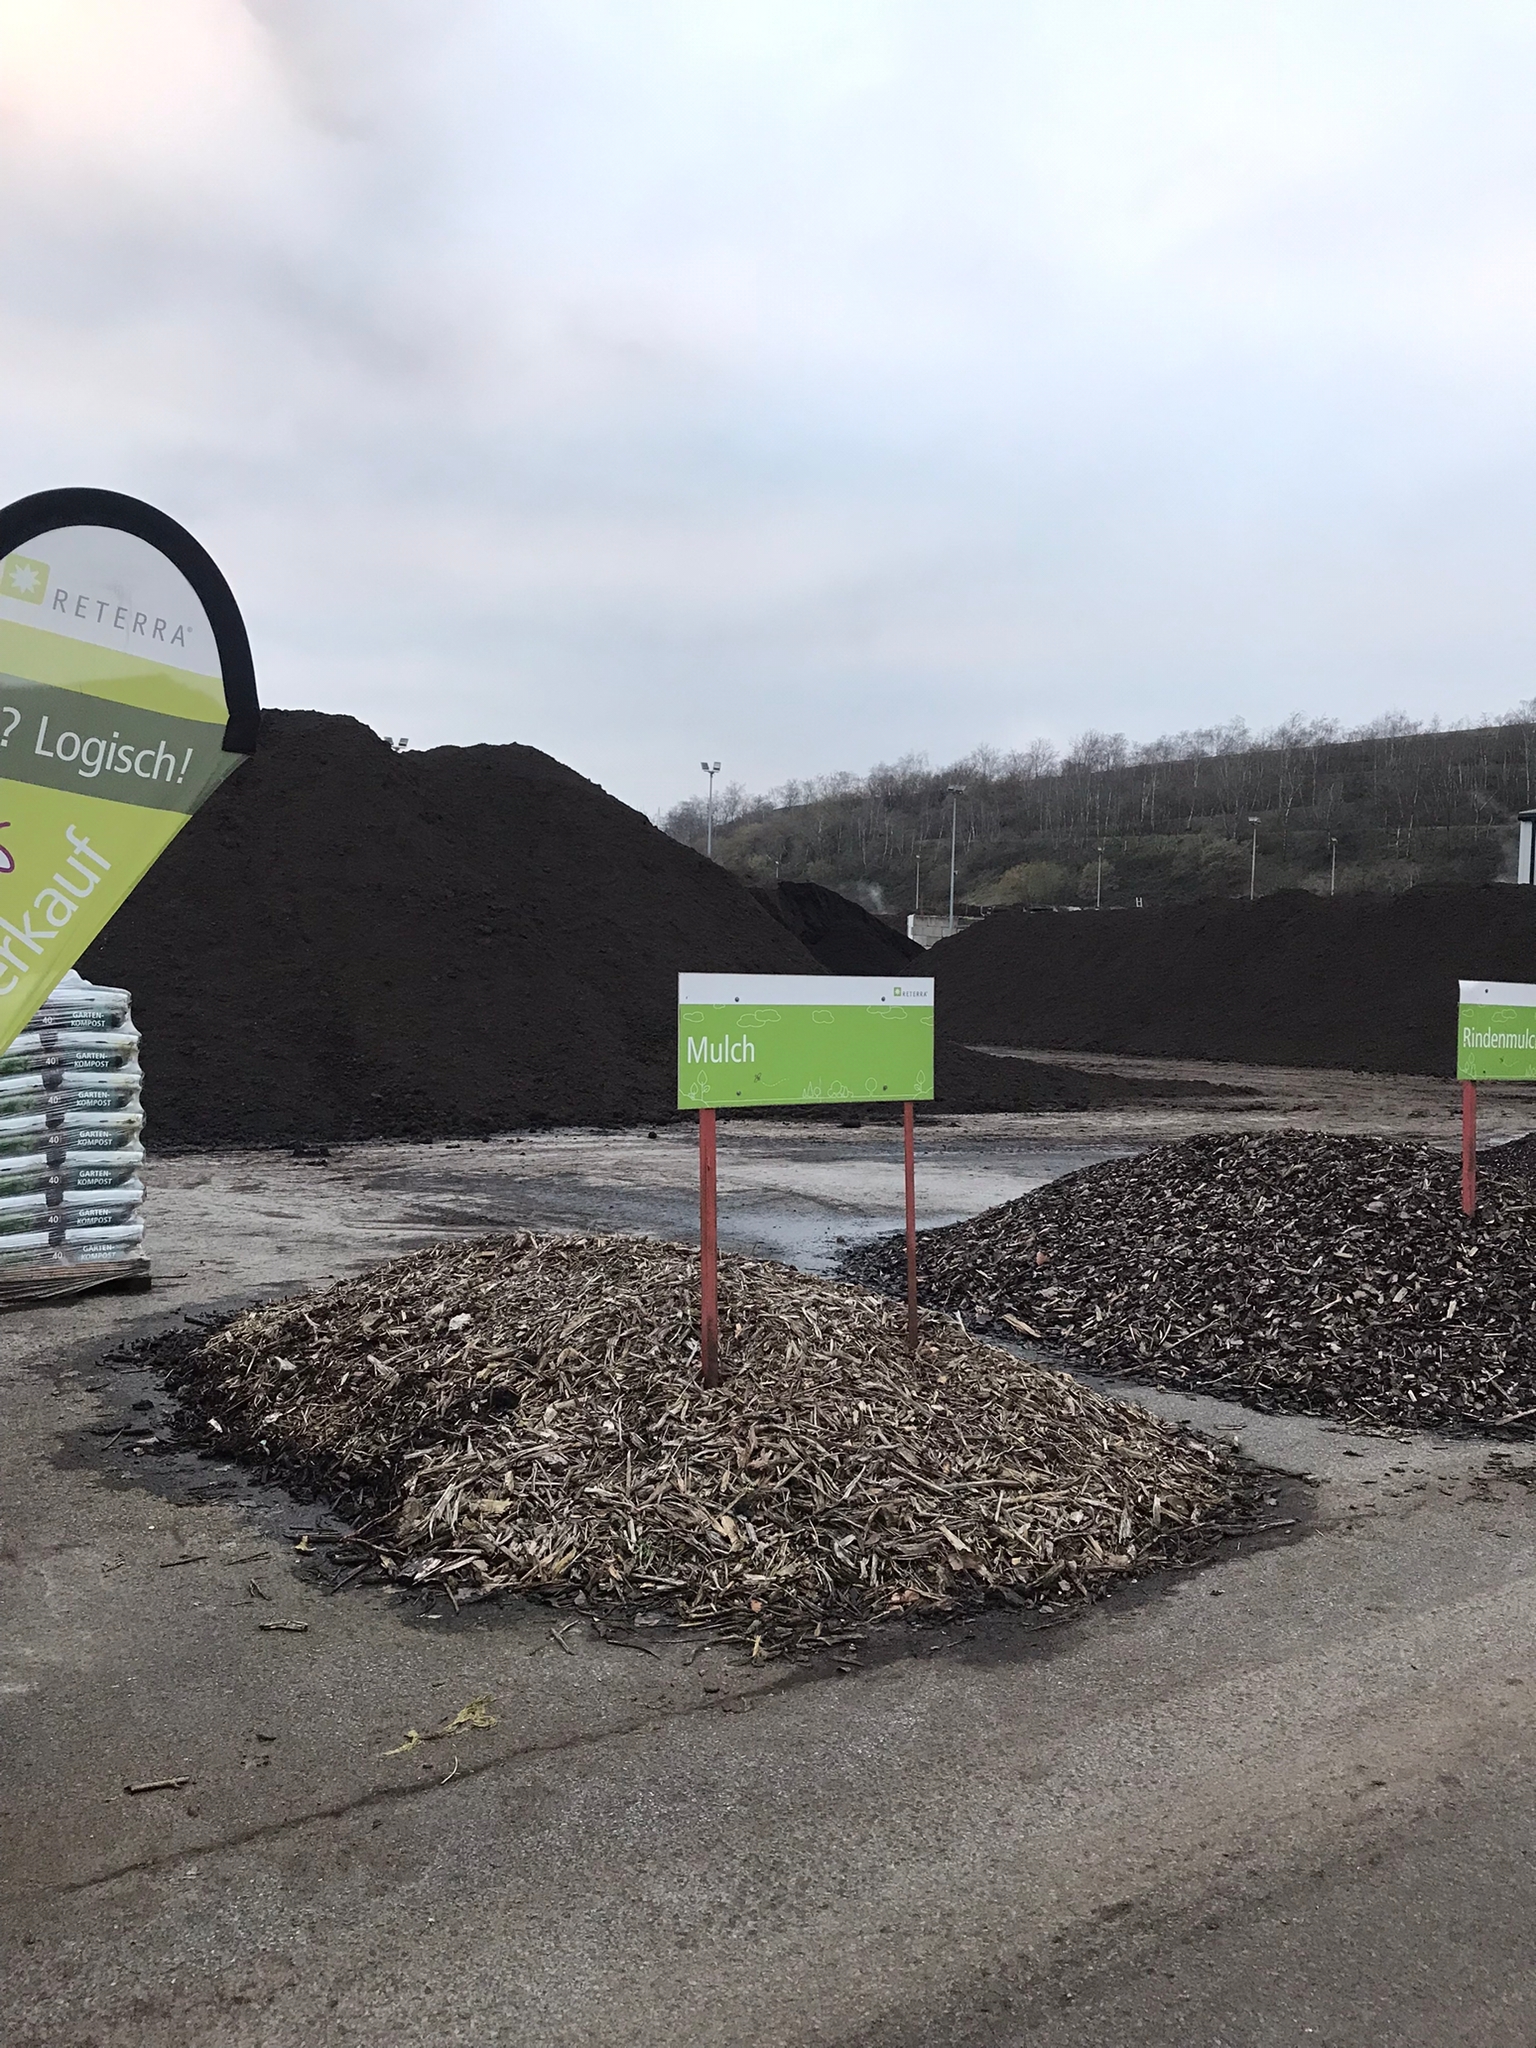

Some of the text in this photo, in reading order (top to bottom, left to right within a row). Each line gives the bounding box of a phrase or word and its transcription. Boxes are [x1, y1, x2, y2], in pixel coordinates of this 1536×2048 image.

[34, 715, 194, 784] Logisch!
[72, 1011, 105, 1019] GARTEN-
[70, 1019, 106, 1027] KOMPOST
[1463, 1026, 1536, 1049] Rindenmulc
[687, 1034, 755, 1063] Mulch
[75, 1052, 108, 1060] GARTEN-
[73, 1060, 110, 1068] KOMPOST
[77, 1091, 111, 1099] GARTEN-
[76, 1099, 112, 1107] KOMPOST
[79, 1130, 112, 1138] GARTEN-
[77, 1138, 113, 1146] KOMPOST
[79, 1170, 112, 1178] GARTEN-
[77, 1178, 113, 1186] KOMPOST
[78, 1209, 112, 1217] GARTEN-
[76, 1216, 112, 1225] KOMPOST
[82, 1244, 116, 1252] GARTEN-
[80, 1252, 117, 1260] KOMPOST
